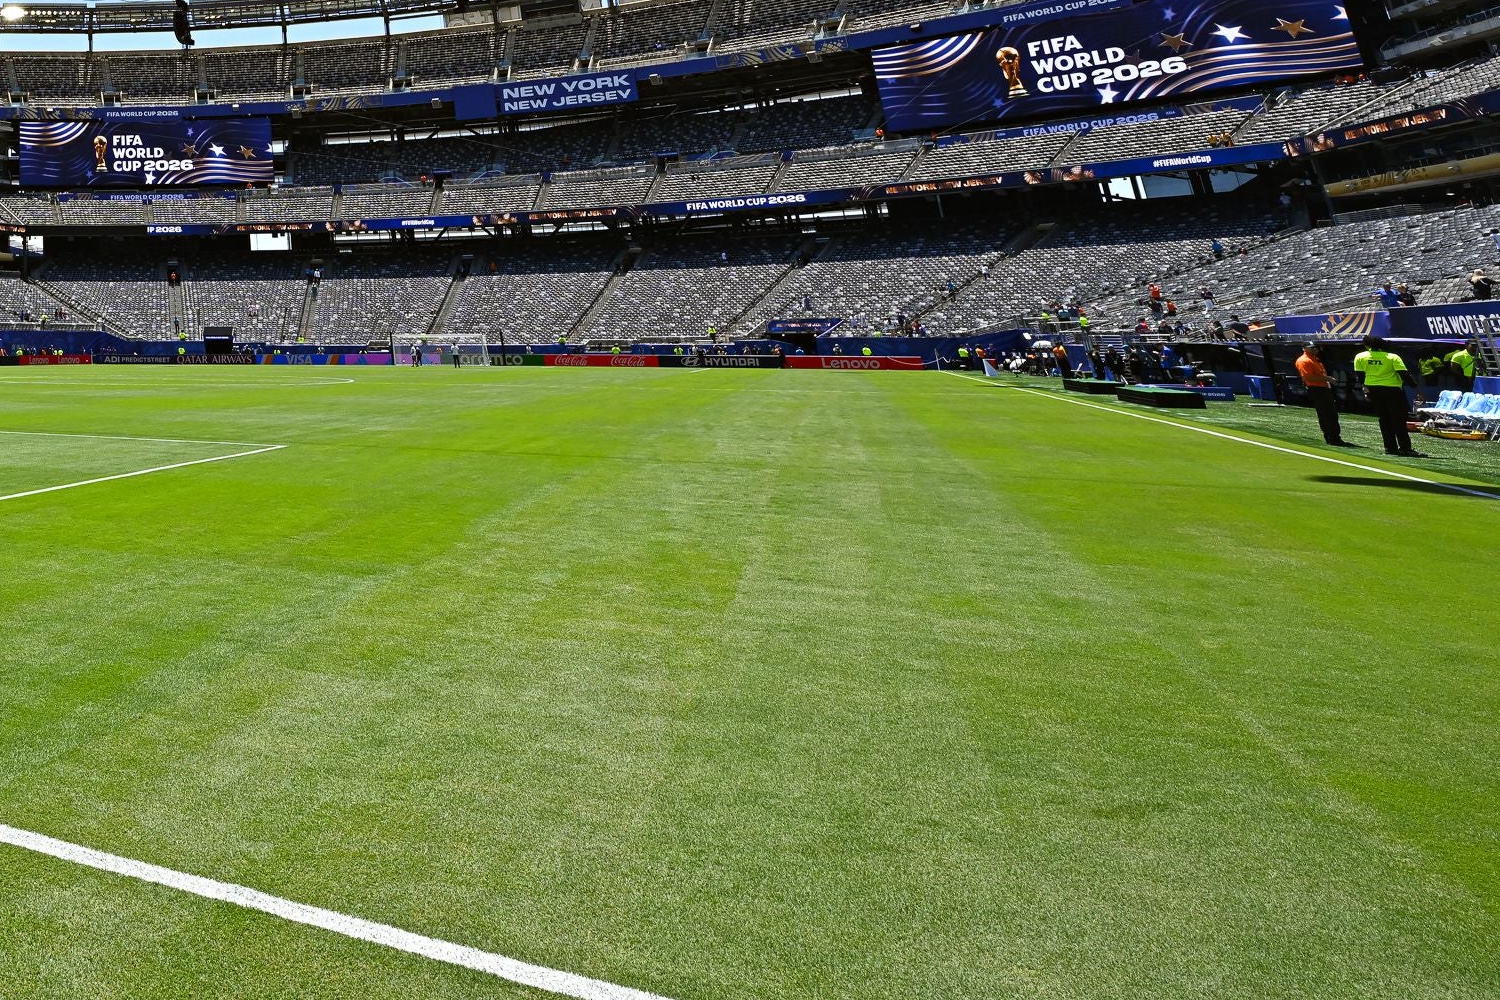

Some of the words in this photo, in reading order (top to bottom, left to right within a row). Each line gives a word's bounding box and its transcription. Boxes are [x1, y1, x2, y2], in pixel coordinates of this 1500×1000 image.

[1002, 13, 1025, 23] FIFA
[1025, 5, 1064, 18] WORLD
[1064, 1, 1086, 11] CUP
[1027, 35, 1083, 57] FIFA
[1030, 47, 1125, 75] WORLD
[1036, 72, 1088, 93] CUP
[1091, 57, 1187, 85] 2026
[502, 83, 556, 99] NEW
[561, 74, 630, 92] YORK
[504, 98, 548, 111] NEW
[552, 89, 631, 107] JERSEY
[1023, 128, 1046, 137] FIFA
[1047, 121, 1090, 134] WORLD
[1090, 118, 1114, 128] CUP
[1115, 112, 1159, 125] 2026
[1344, 129, 1363, 140] NEW
[1364, 122, 1388, 135] YORK
[1389, 118, 1410, 130] NEW
[1410, 109, 1447, 125] JERSEY
[113, 135, 143, 145] FIFA
[113, 147, 164, 158] WORLD
[1153, 155, 1212, 167] #FIFAWorldCup
[113, 160, 141, 171] CUP
[143, 160, 194, 171] 2026
[885, 185, 908, 194] NEW
[908, 183, 937, 192] YORK
[963, 176, 1003, 187] JERSEY
[686, 202, 709, 211] FIFA
[709, 199, 745, 209] WORLD
[746, 197, 767, 206] CUP
[767, 194, 806, 204] 2026
[1426, 315, 1452, 334] FIFA
[29, 356, 49, 364] Lenovo
[58, 356, 80, 364] Lenovo
[177, 355, 207, 364] QATAR
[212, 355, 252, 364] AIRWAYS
[286, 355, 313, 364] VISA
[705, 357, 759, 367] HYUNDAI
[821, 358, 880, 369] Lenovo
